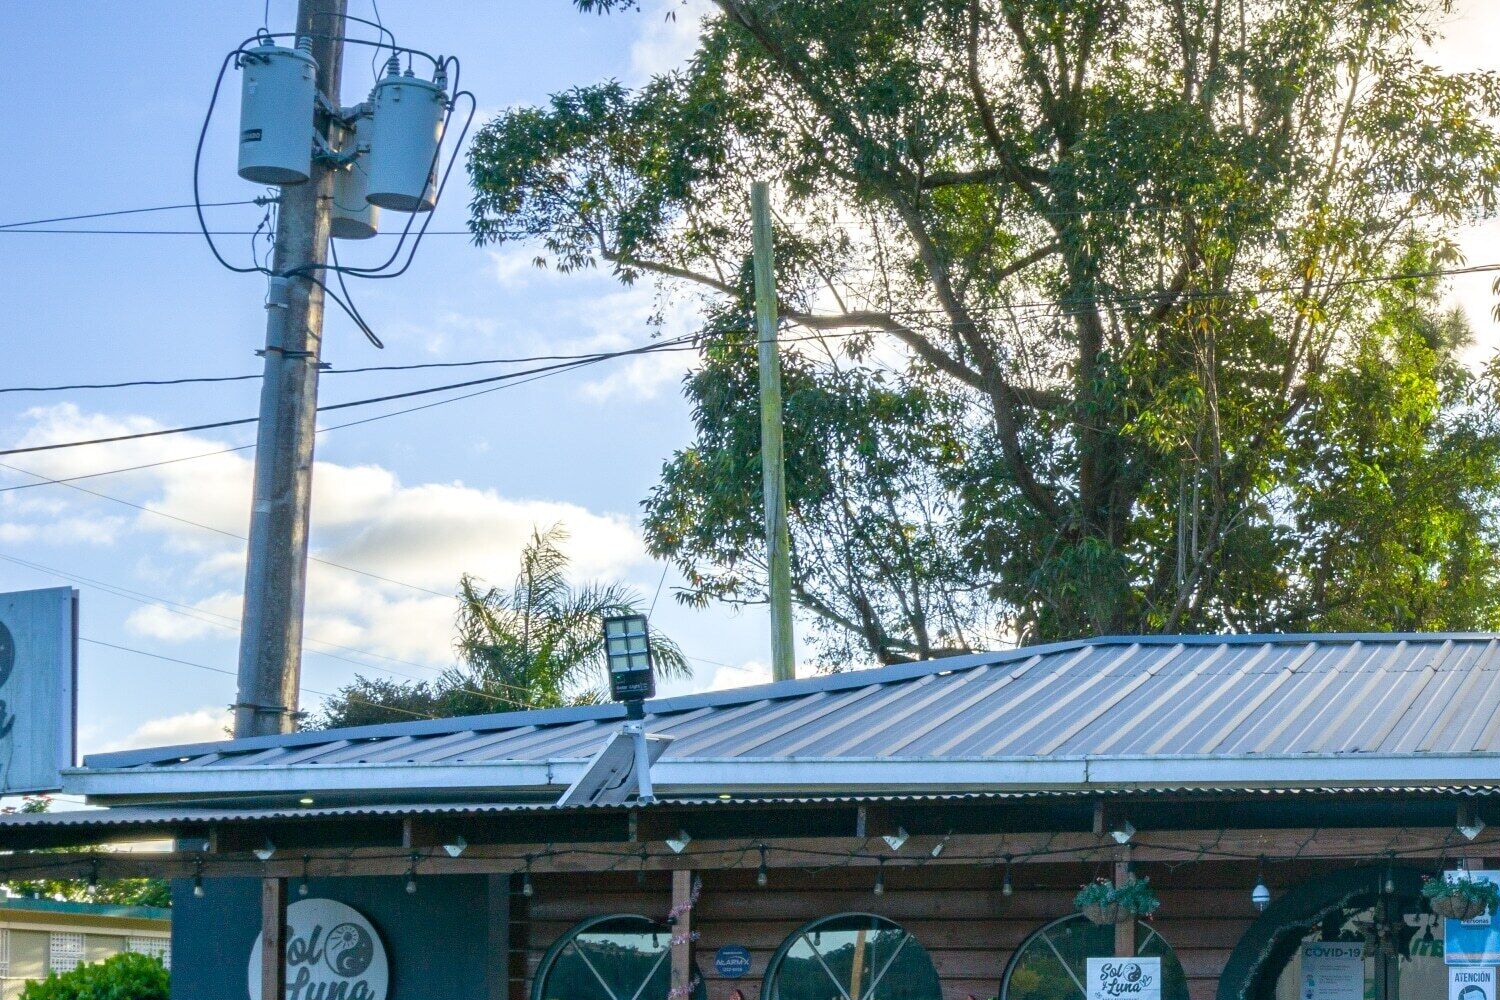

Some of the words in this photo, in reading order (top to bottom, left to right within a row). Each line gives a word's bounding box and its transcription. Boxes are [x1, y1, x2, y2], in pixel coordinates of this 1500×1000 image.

[286, 924, 323, 966] ol
[1306, 948, 1360, 957] COVID-19
[1100, 963, 1123, 980] Sol
[1107, 978, 1142, 997] Luna
